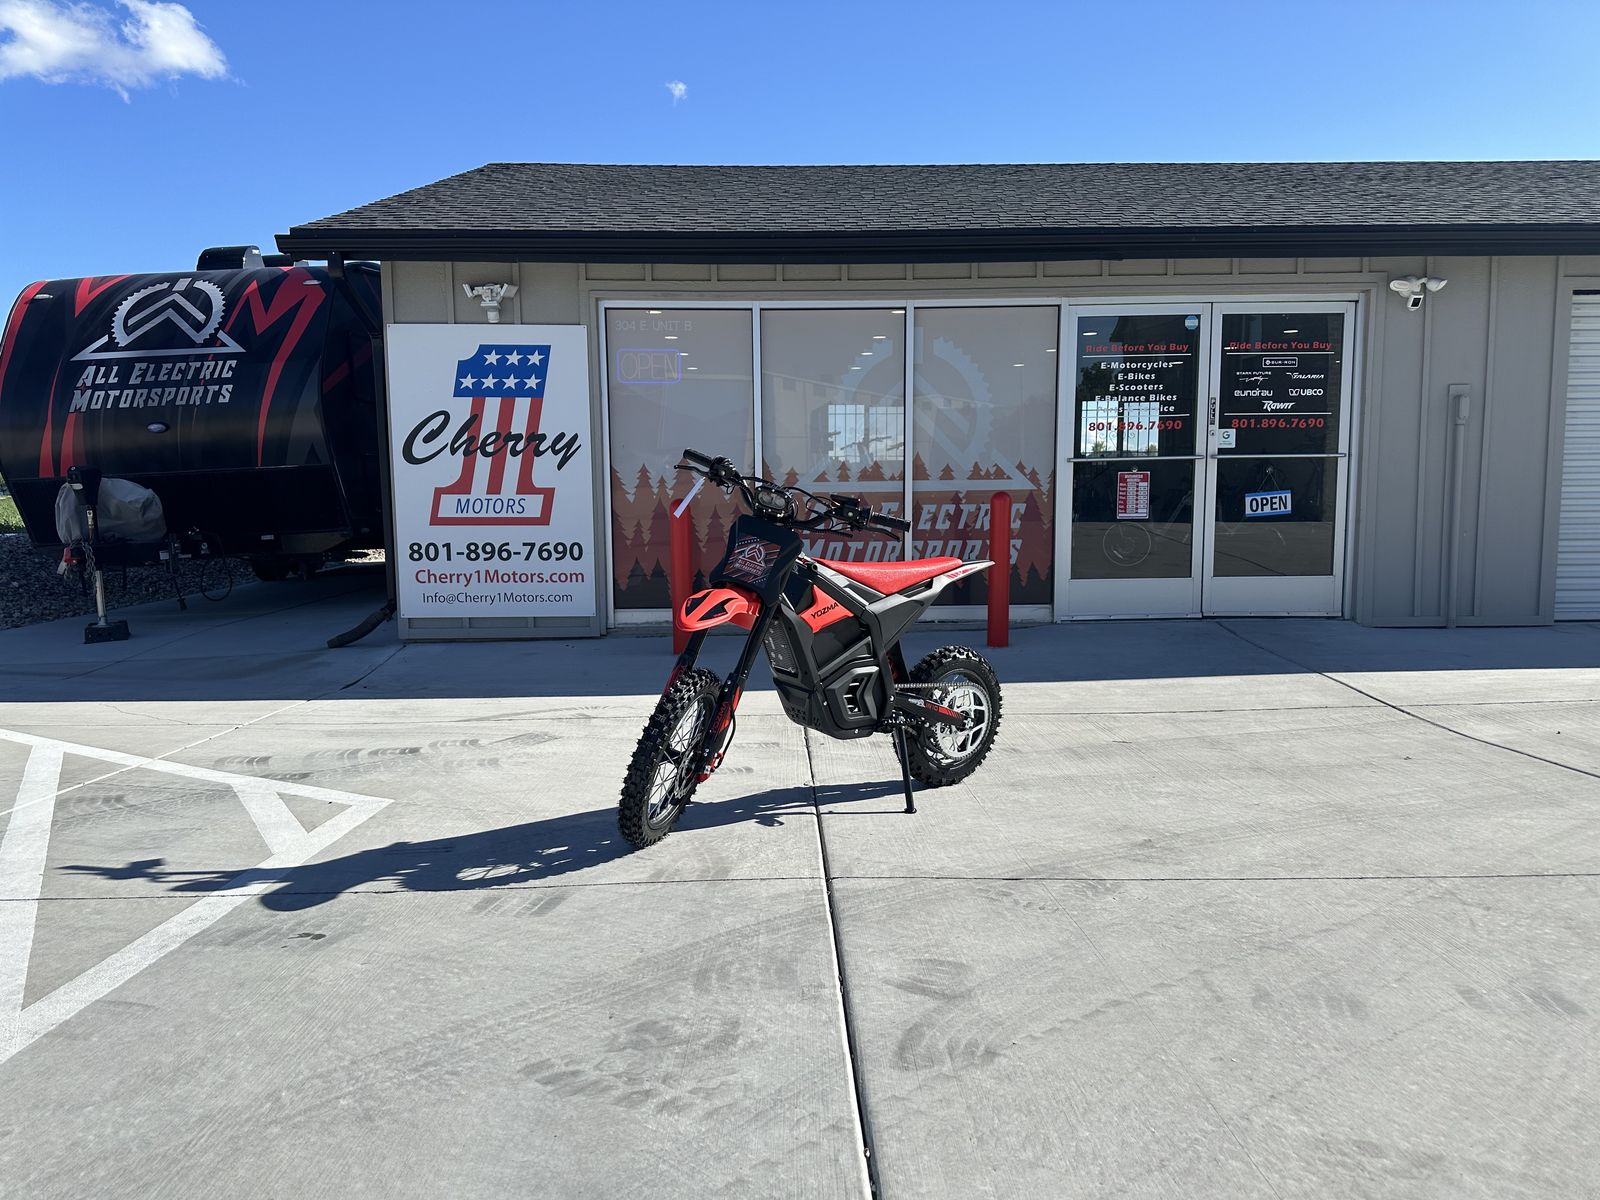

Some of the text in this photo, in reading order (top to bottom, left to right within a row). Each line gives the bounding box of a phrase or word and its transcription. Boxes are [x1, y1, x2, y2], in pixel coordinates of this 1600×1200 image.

[615, 319, 636, 331] 304
[652, 319, 681, 331] UNIT
[1085, 344, 1108, 353] Ride
[1111, 344, 1145, 352] Before
[1169, 343, 1189, 352] Buy
[1229, 341, 1332, 350] Ride Before You Buy
[620, 352, 678, 380] OPEN
[1100, 361, 1173, 370] E-Motorcycles
[76, 360, 238, 387] ALL ELECTRIC
[1117, 372, 1156, 380] E-Bikes
[69, 384, 234, 413] MOTORSPORTS
[1095, 394, 1146, 402] E-Balance
[1300, 388, 1324, 396] UBCO
[1088, 420, 1183, 431] 801.896.7690
[1231, 418, 1325, 428] 801.896.7690
[402, 409, 582, 471] Cherry
[455, 498, 526, 514] MOTORS
[1250, 495, 1288, 512] OPEN
[408, 542, 584, 562] 801-896-7690
[415, 569, 585, 587] Cherry1Motors.com
[422, 591, 573, 606] Info@Cherry1Motors.com
[811, 602, 839, 619] YOZMA
